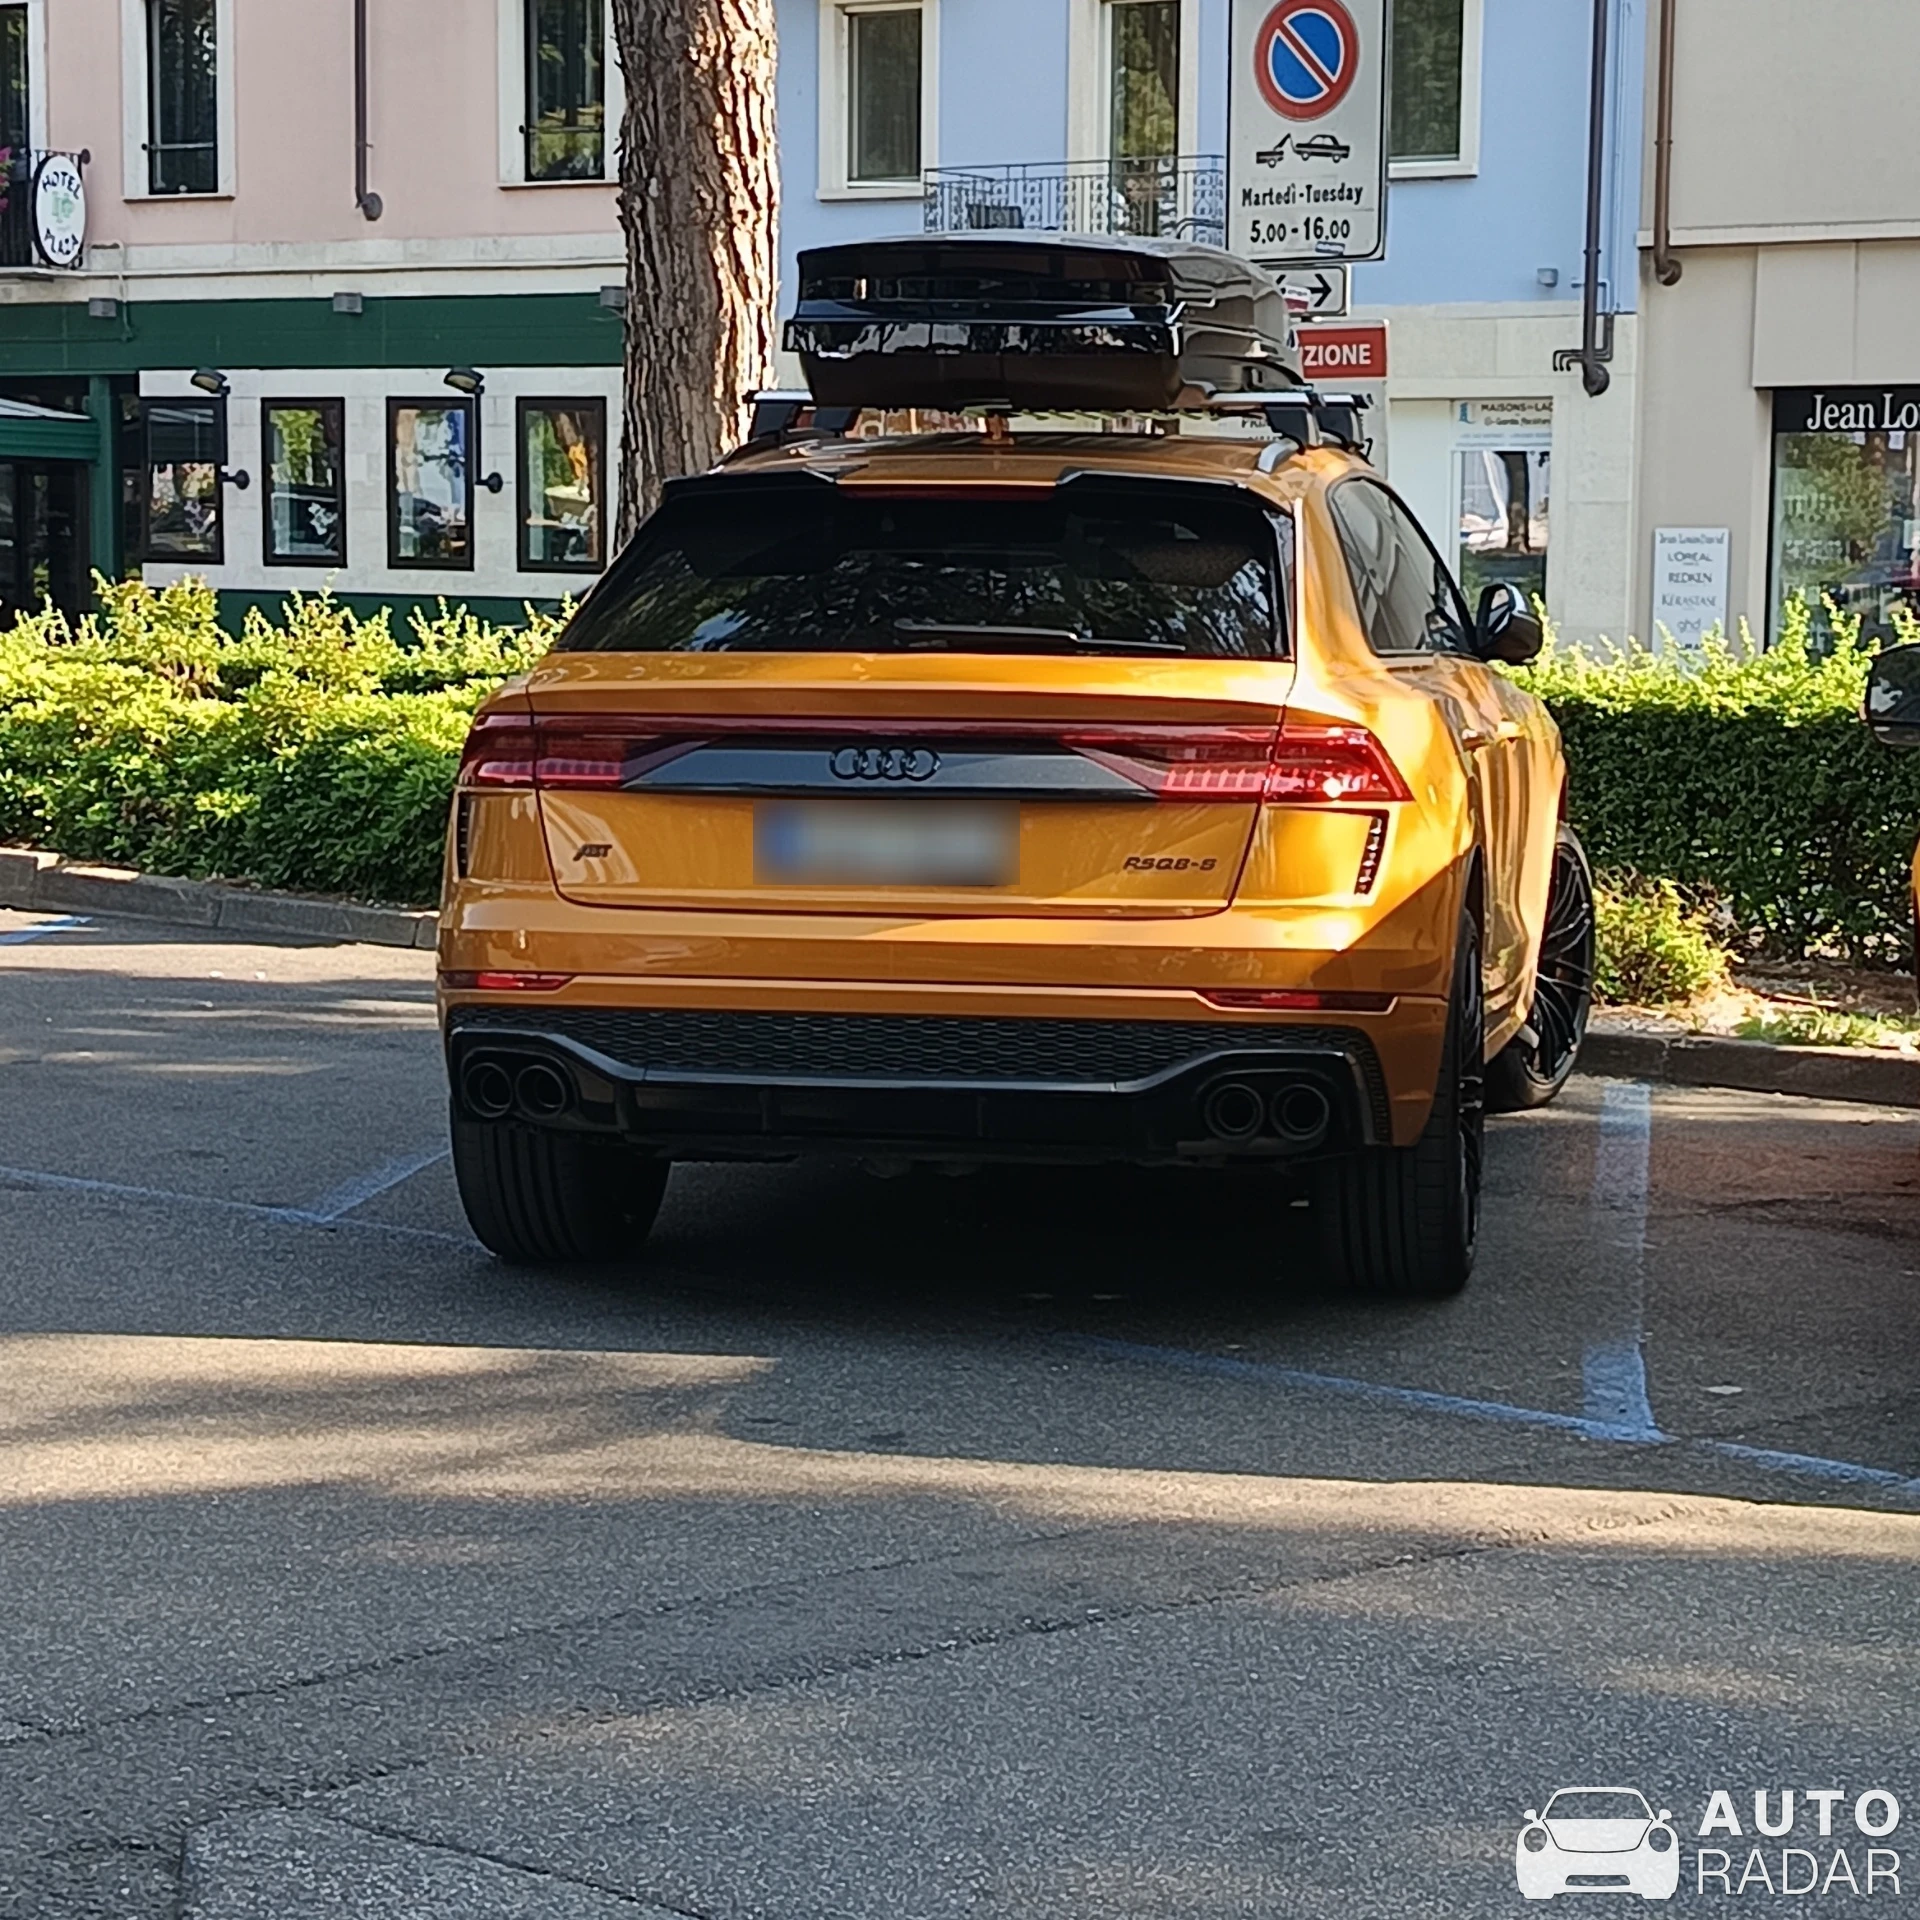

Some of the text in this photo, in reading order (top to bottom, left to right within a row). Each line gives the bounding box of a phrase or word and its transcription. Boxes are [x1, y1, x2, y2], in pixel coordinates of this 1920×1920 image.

[42, 171, 80, 200] HOTEL
[1304, 344, 1371, 366] ZIONE
[1806, 393, 1920, 430] Jean Lo
